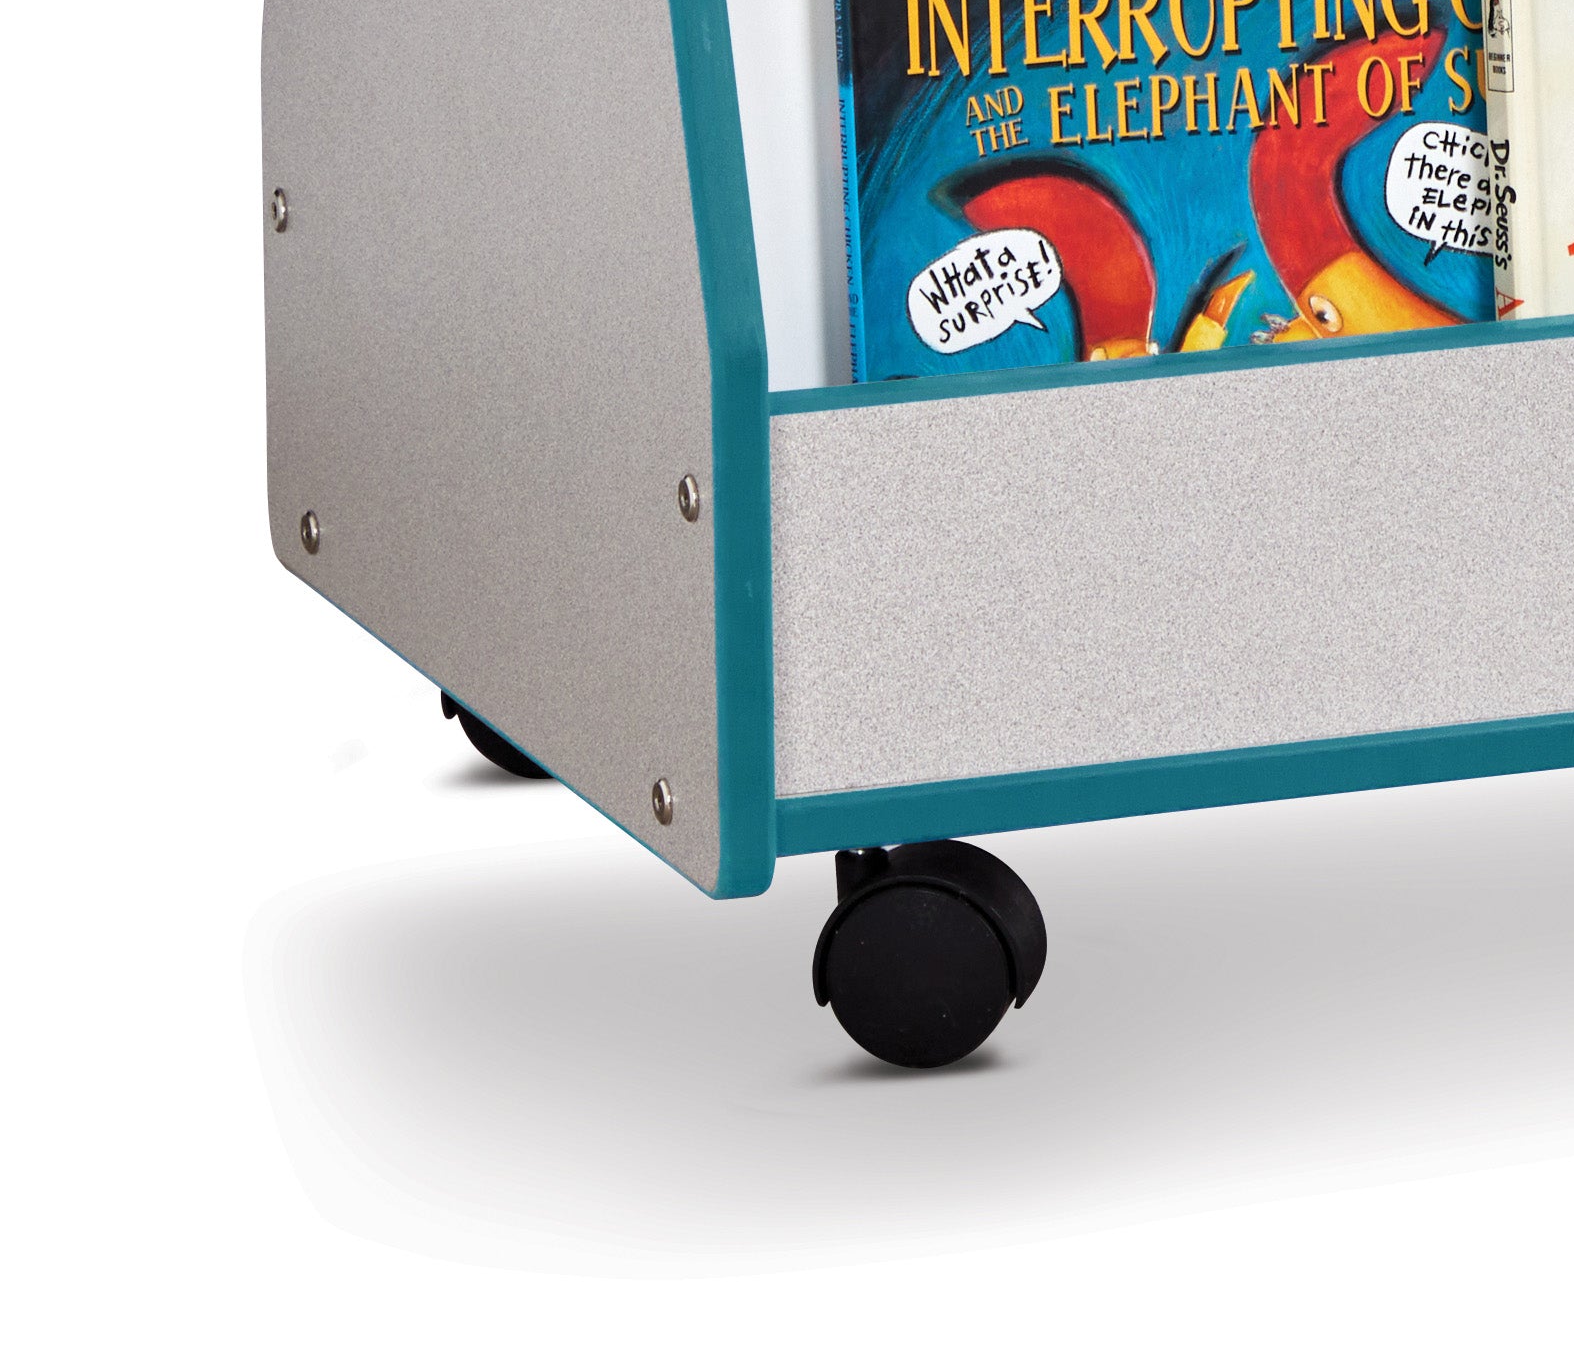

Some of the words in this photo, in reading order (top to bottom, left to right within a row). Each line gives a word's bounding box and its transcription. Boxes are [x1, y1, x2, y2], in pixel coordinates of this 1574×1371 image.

[965, 85, 1024, 127] AND
[1046, 62, 1335, 147] ELEPHANT
[1355, 52, 1424, 119] OF
[970, 118, 1029, 157] THE
[1490, 139, 1510, 181] Dr.
[1441, 219, 1492, 247] this
[1494, 181, 1517, 270] Seuss's
[998, 246, 1017, 267] a
